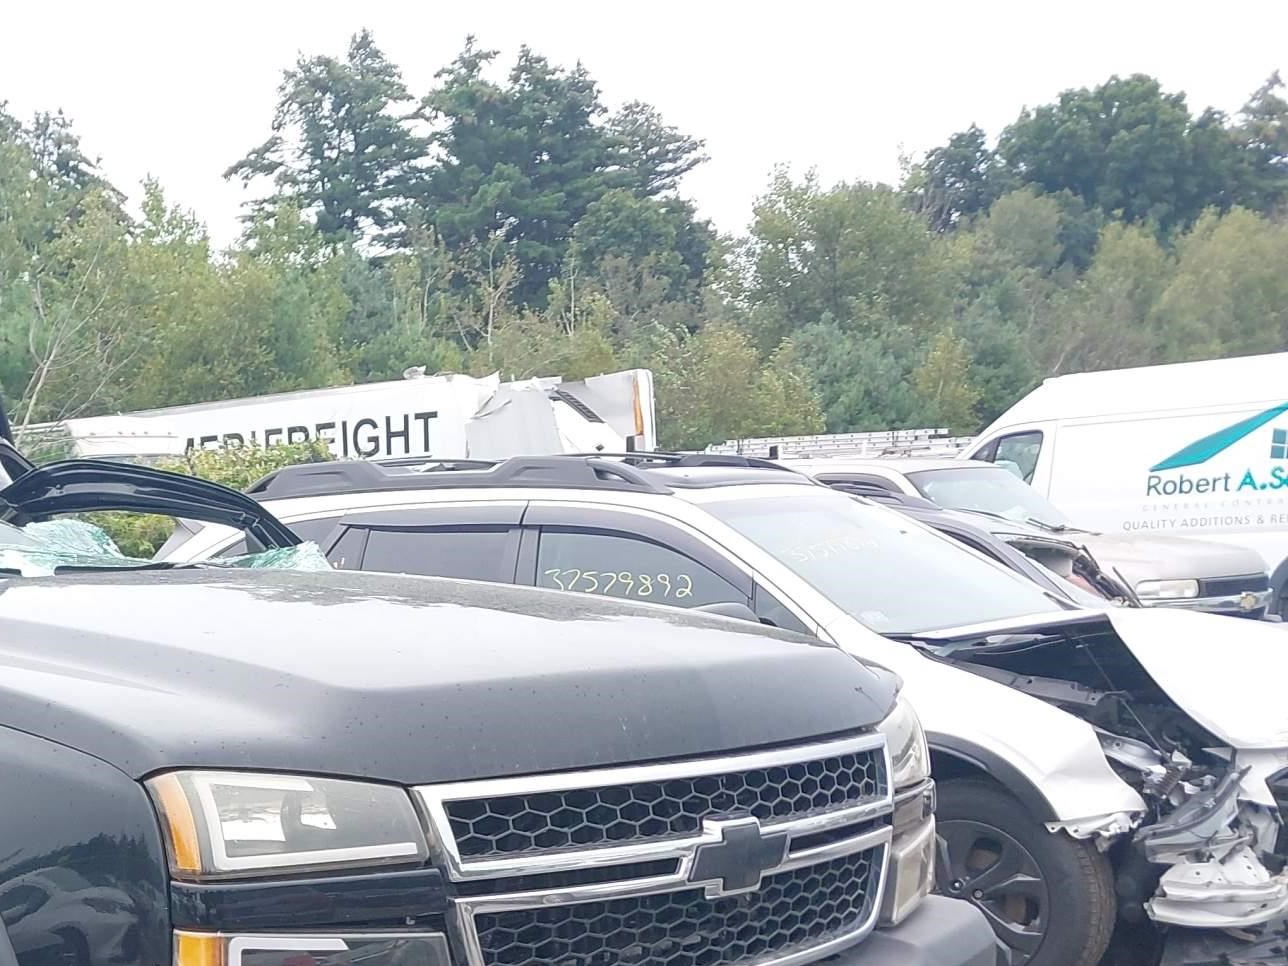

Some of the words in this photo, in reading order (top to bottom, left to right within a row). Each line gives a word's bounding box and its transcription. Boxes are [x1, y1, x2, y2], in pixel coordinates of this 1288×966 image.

[1147, 473, 1231, 496] Robert
[1122, 519, 1176, 531] QUALITY
[1181, 515, 1251, 528] ADDITIONS
[1257, 514, 1264, 524] &
[544, 568, 693, 598] 37579892
